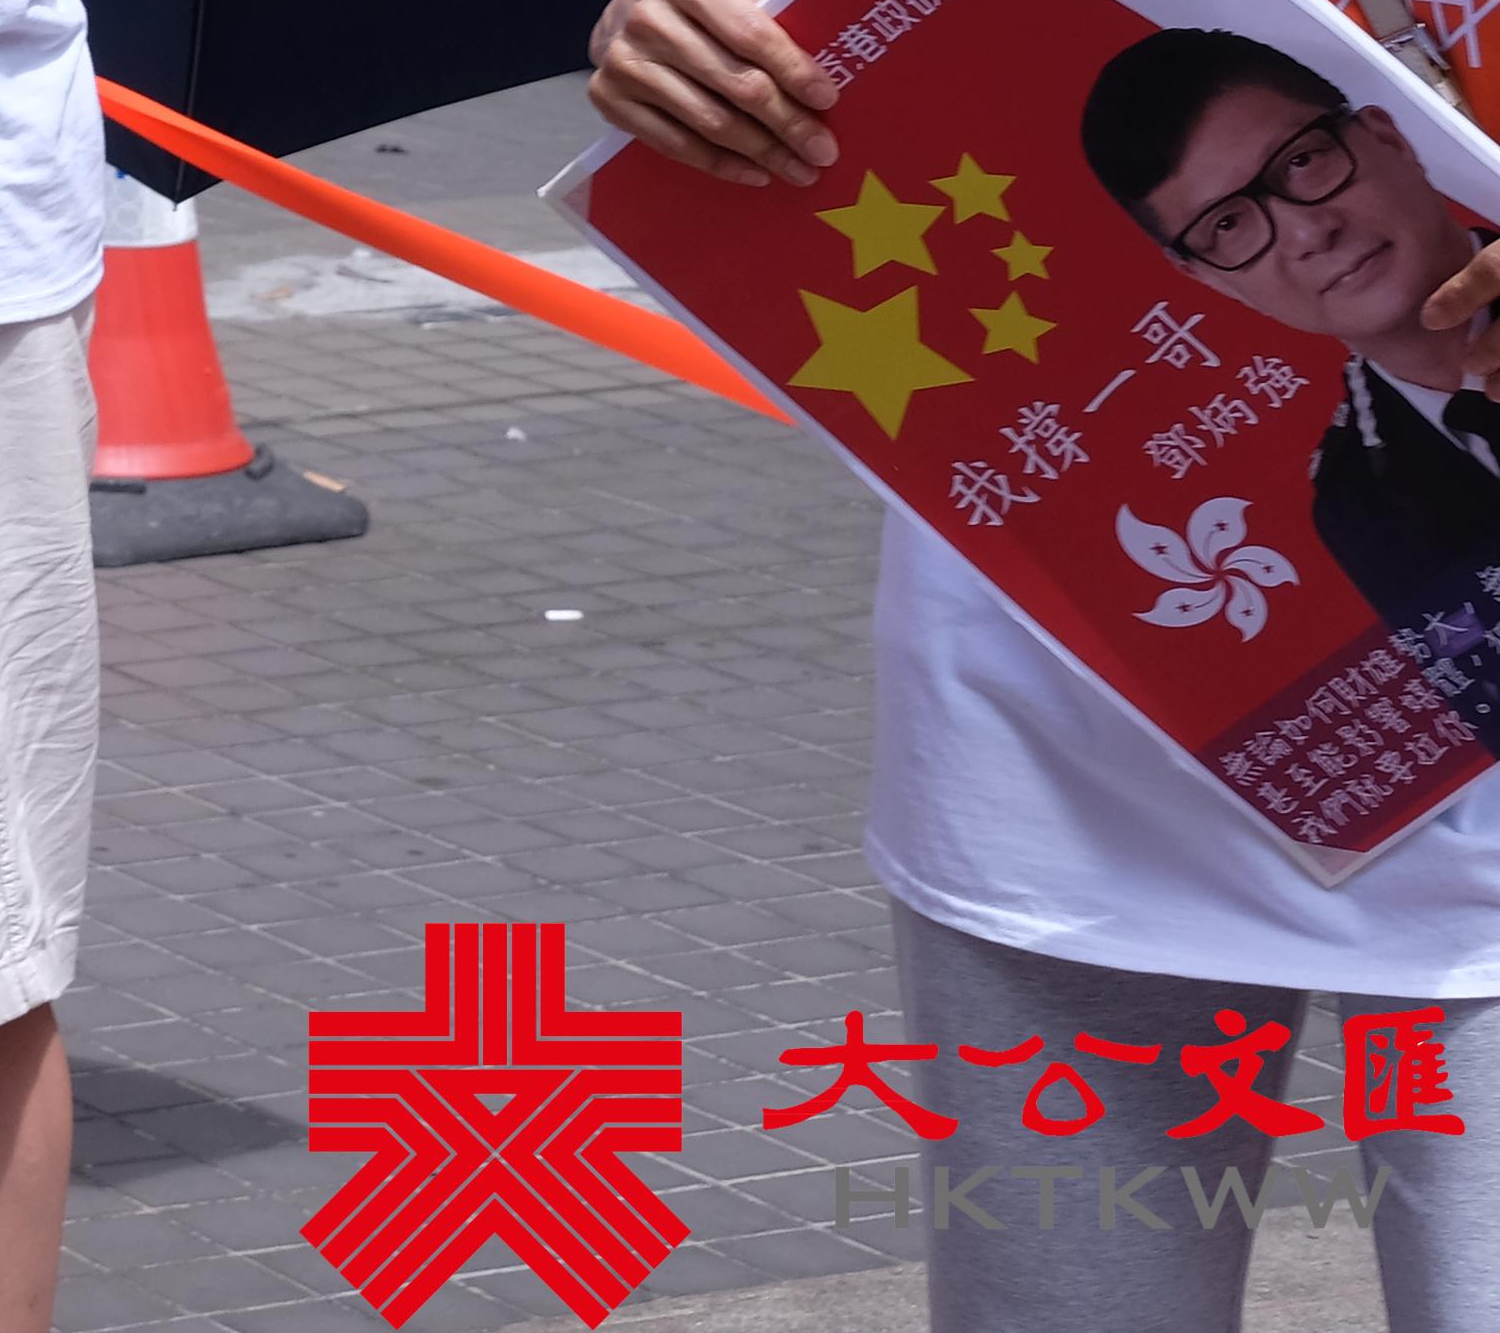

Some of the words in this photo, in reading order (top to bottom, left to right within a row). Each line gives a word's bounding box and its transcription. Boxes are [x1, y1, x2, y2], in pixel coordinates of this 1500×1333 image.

[949, 301, 1221, 526] 我撐一哥
[1142, 355, 1310, 480] 鄧炳強
